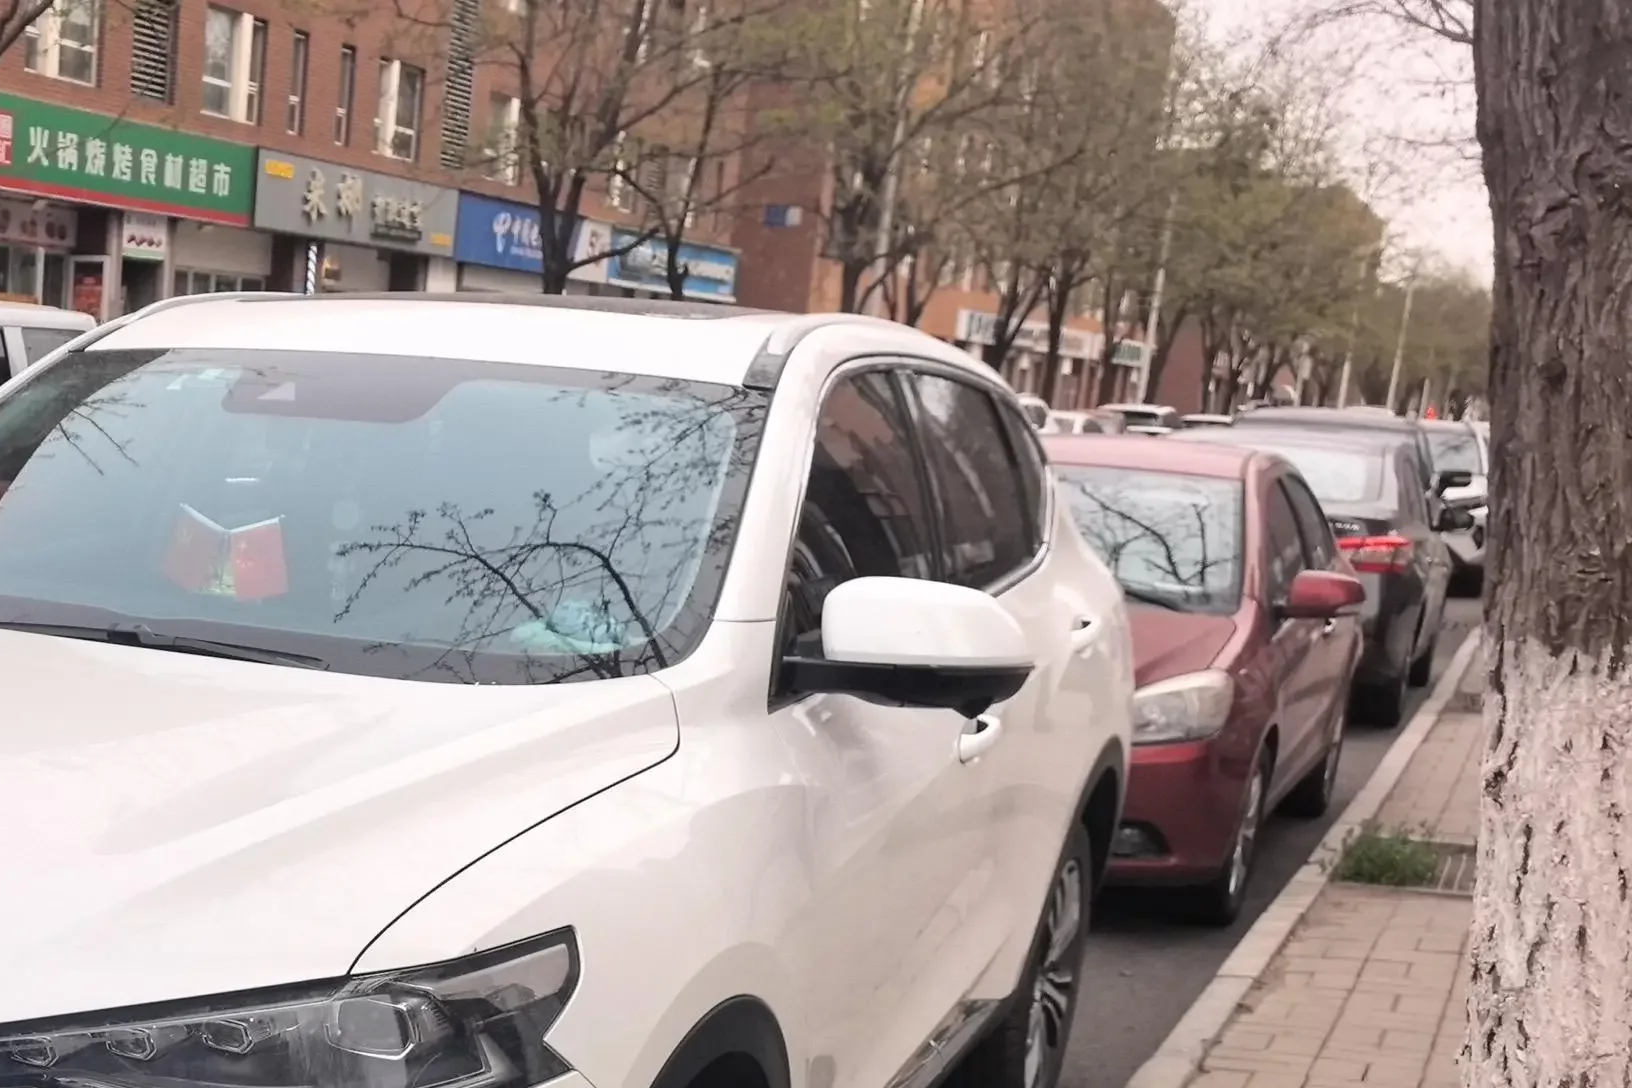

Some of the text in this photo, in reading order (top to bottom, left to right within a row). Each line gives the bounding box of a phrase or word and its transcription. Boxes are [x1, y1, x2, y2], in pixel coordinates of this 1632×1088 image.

[27, 126, 231, 197] 火锅烧烤食材超市
